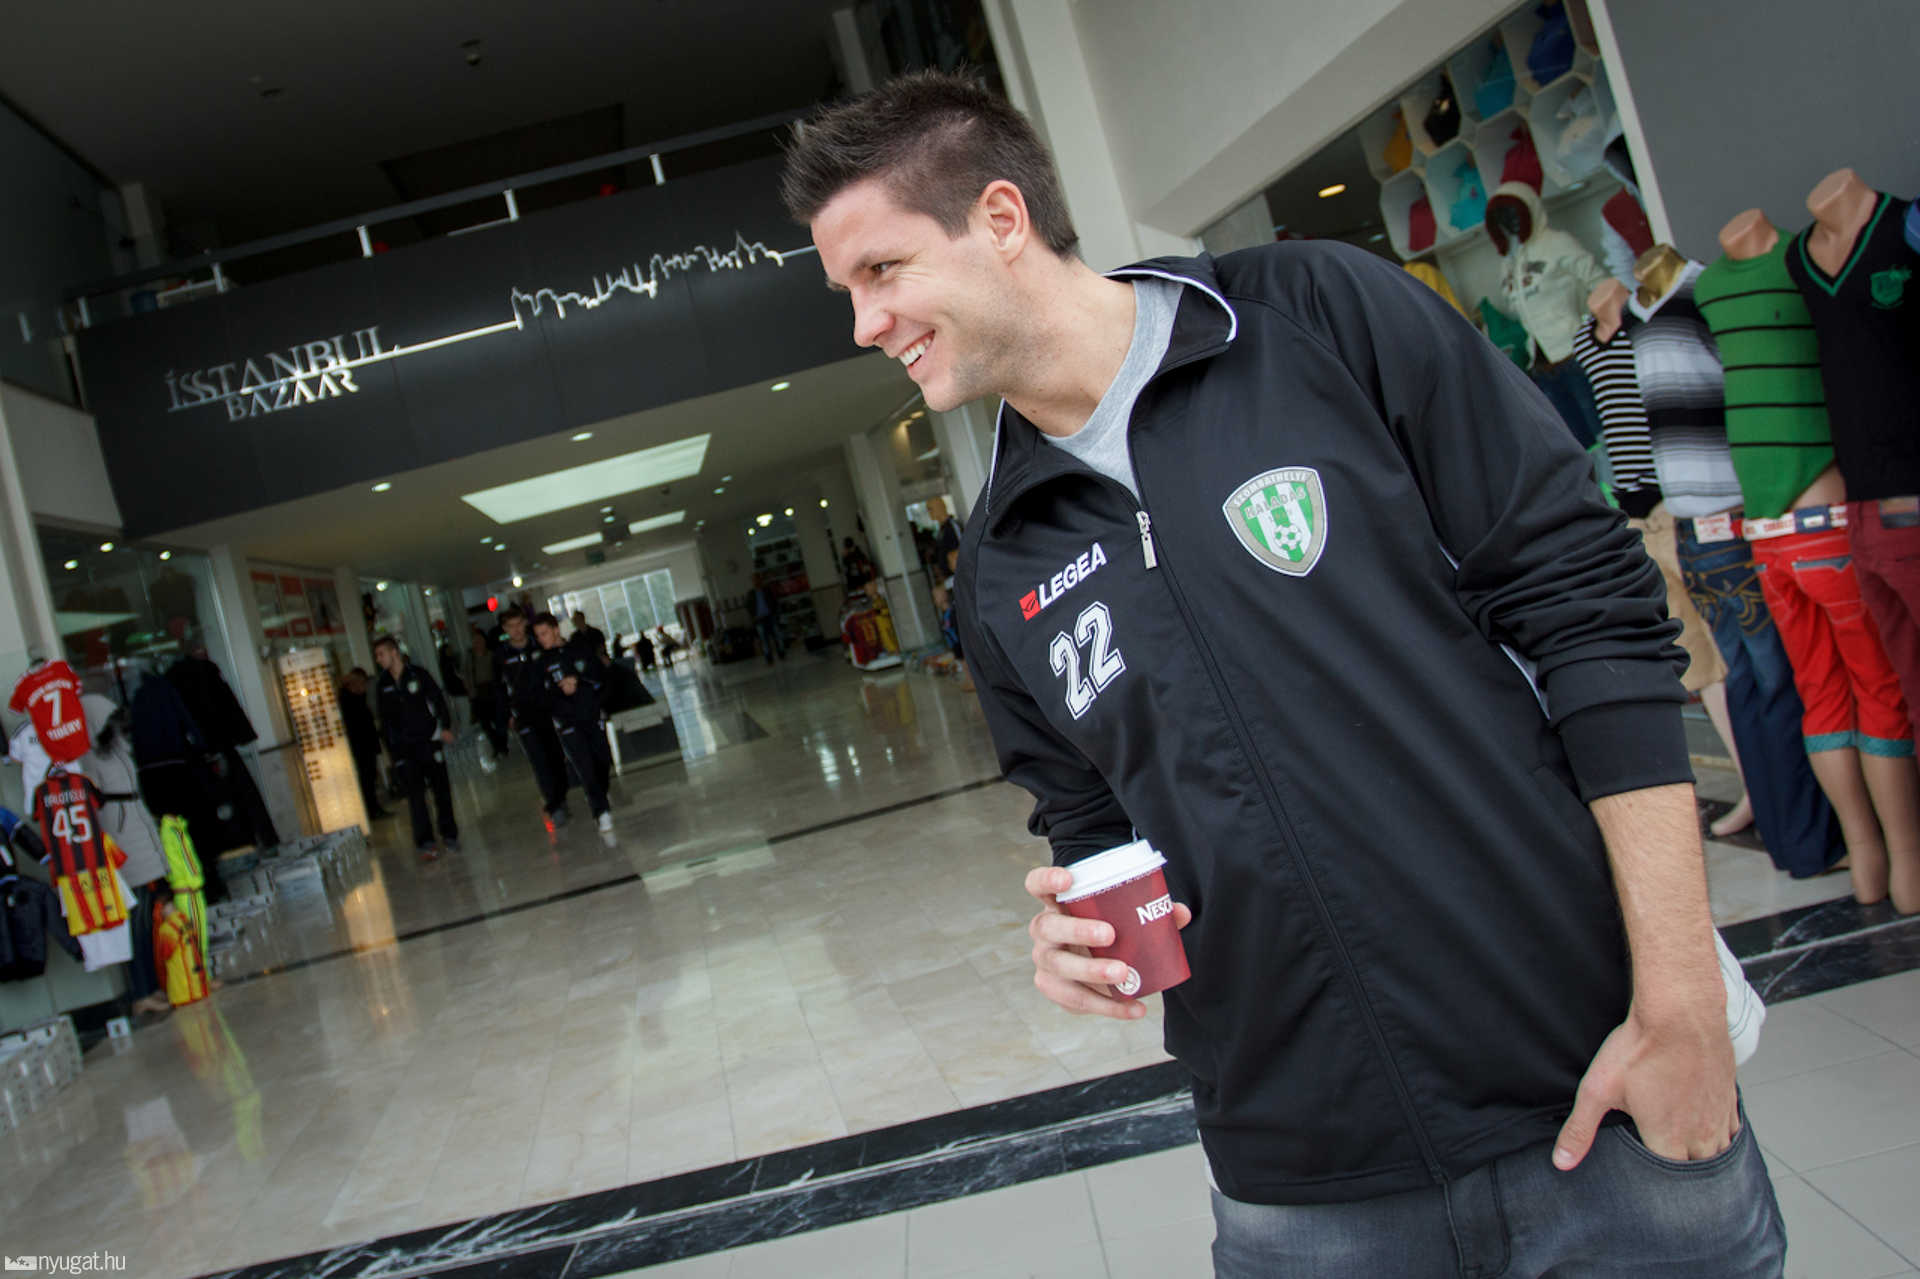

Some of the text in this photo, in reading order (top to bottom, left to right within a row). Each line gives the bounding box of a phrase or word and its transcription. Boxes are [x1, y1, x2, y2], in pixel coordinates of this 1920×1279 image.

[225, 367, 360, 422] BAZAAR
[1039, 542, 1107, 609] LEGEA
[1050, 601, 1127, 720] 22
[43, 690, 62, 727] 7
[53, 804, 92, 845] 45
